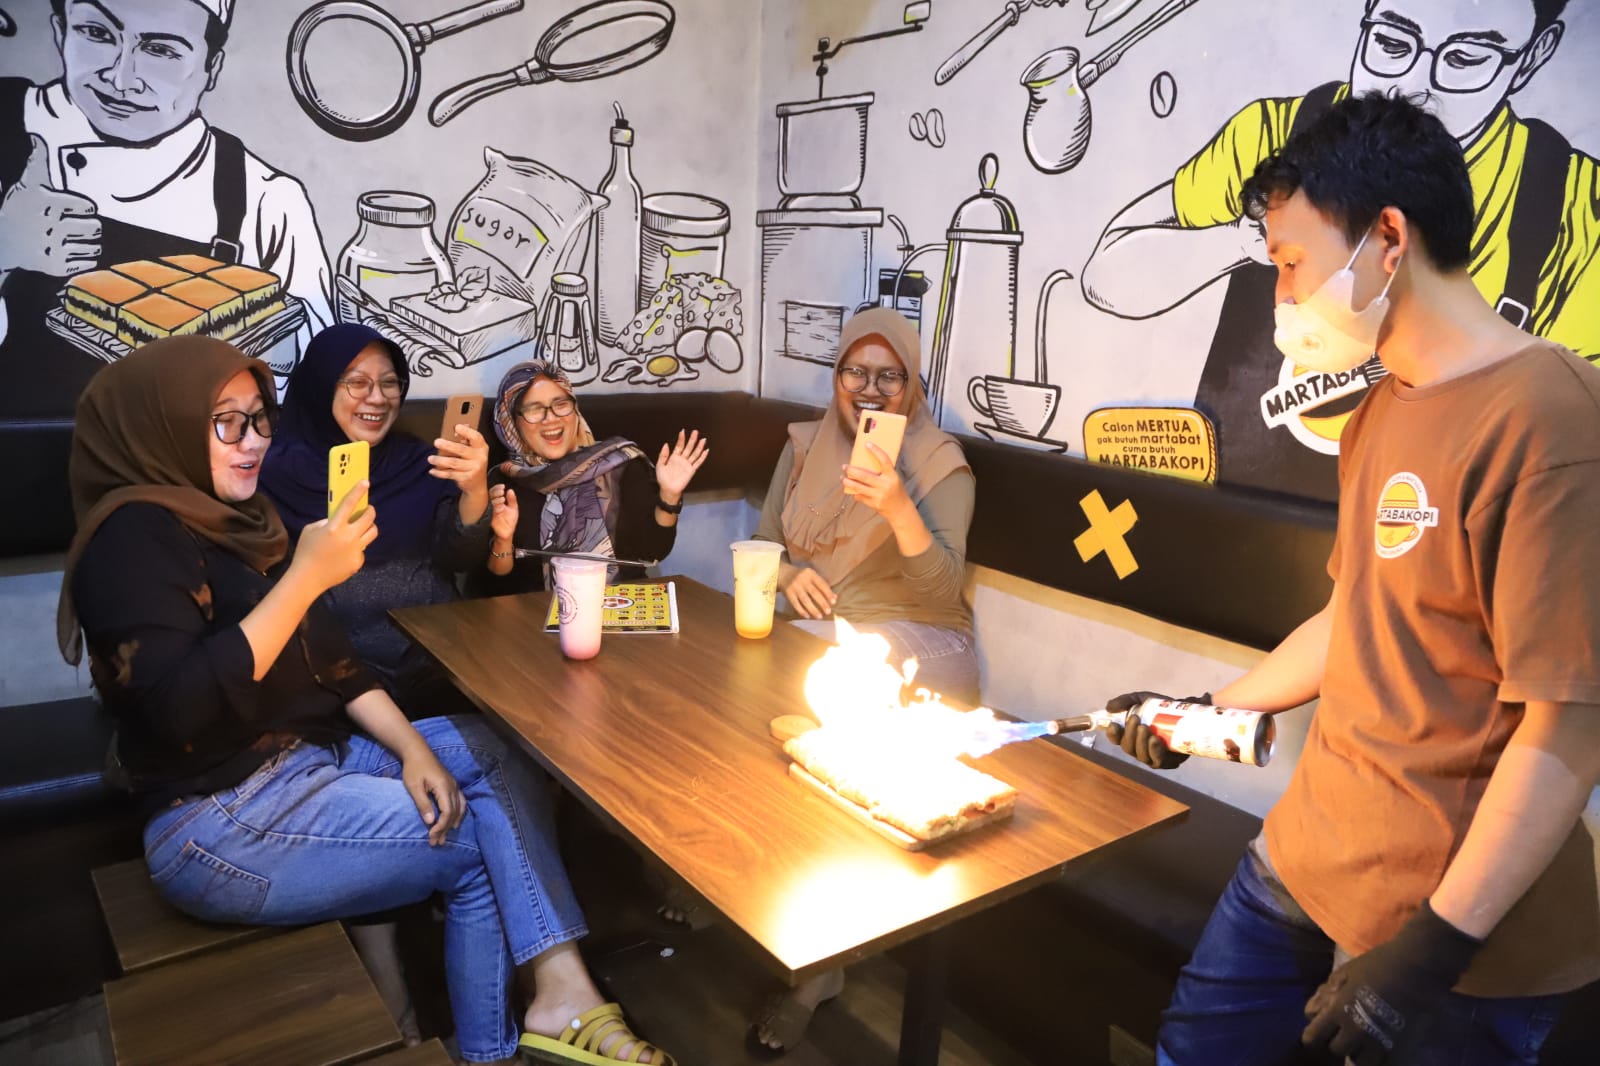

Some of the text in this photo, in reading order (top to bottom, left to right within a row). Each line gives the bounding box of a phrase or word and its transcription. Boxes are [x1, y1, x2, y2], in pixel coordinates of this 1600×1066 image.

[1102, 420, 1192, 433] Calon MERTUA
[1097, 434, 1201, 445] gak butuh martabat
[1122, 444, 1176, 454] cuma butuh
[1099, 454, 1205, 471] MARTABAKOPI
